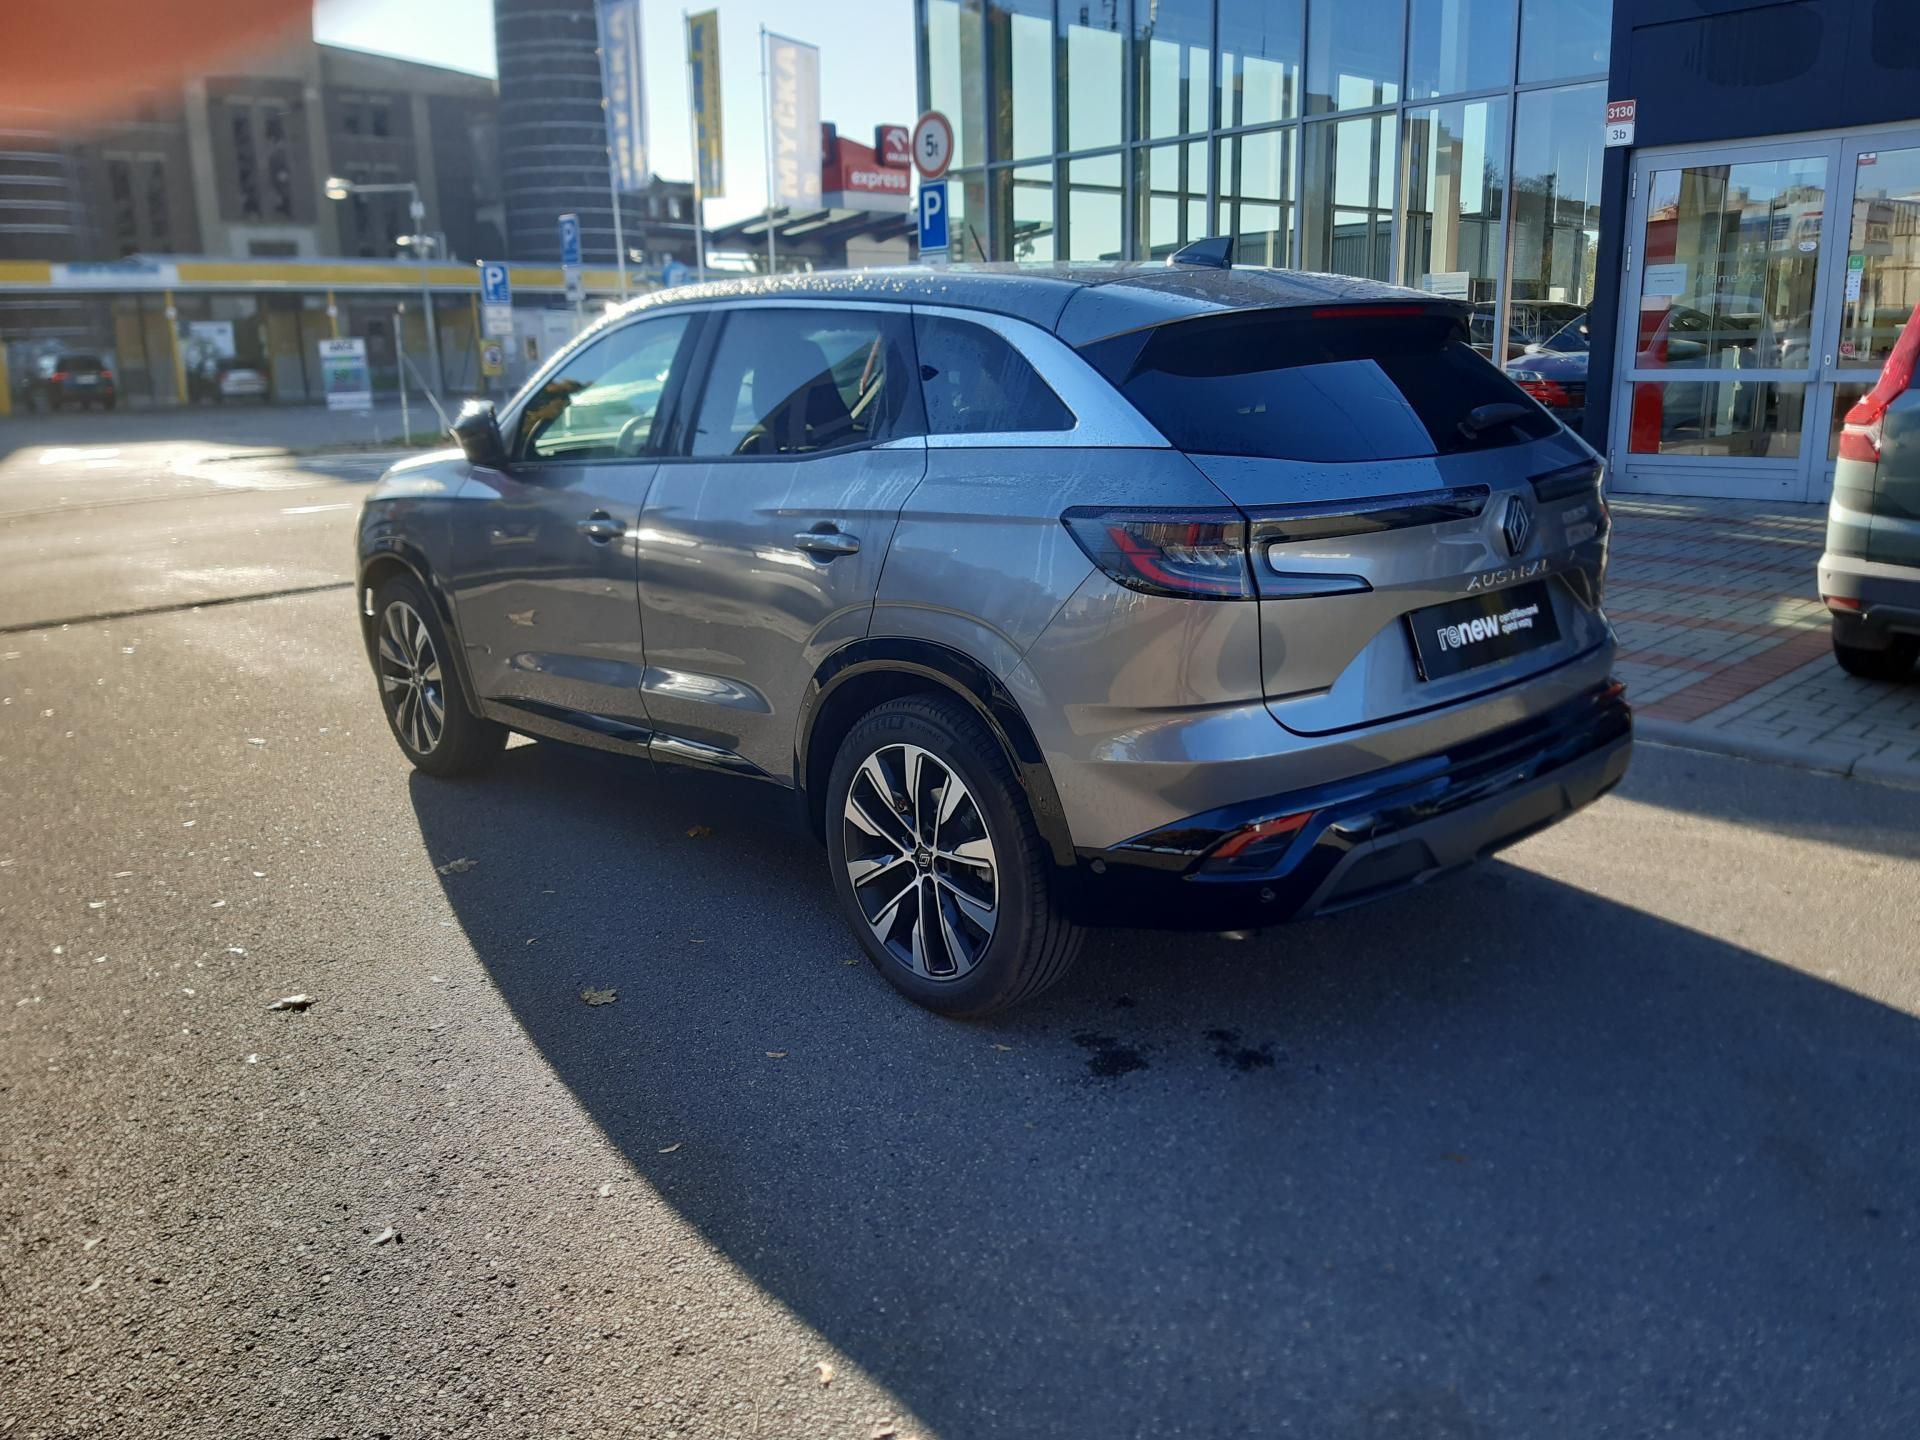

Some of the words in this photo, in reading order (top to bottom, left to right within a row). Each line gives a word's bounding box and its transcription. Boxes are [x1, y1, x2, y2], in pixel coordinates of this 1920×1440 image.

[1608, 105, 1634, 119] 3130
[925, 133, 940, 158] 5t
[1612, 129, 1627, 141] 3b
[851, 170, 907, 190] express
[923, 190, 942, 231] P
[486, 266, 503, 291] P
[1437, 615, 1498, 651] renew
